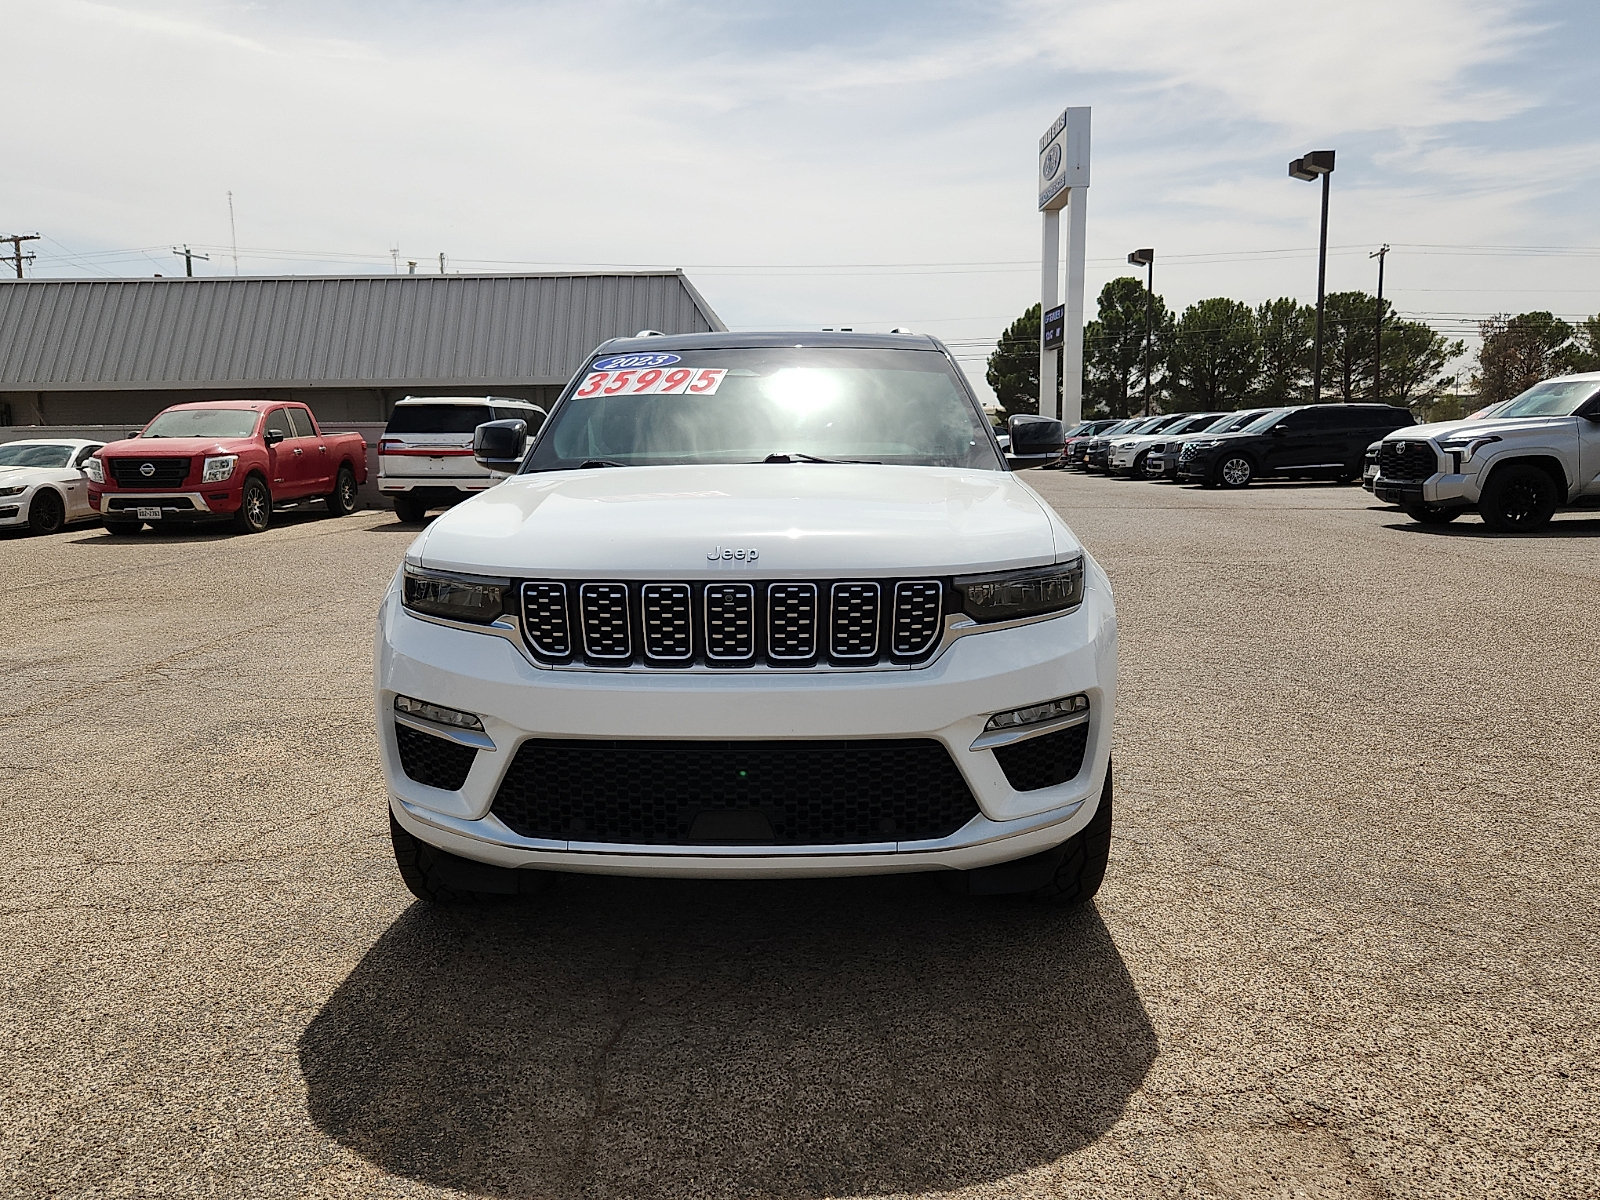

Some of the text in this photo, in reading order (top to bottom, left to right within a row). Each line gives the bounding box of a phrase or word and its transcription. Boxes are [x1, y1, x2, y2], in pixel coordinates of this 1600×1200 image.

[604, 355, 670, 369] 2023
[577, 369, 723, 396] 35995
[706, 545, 759, 562] Jeep
